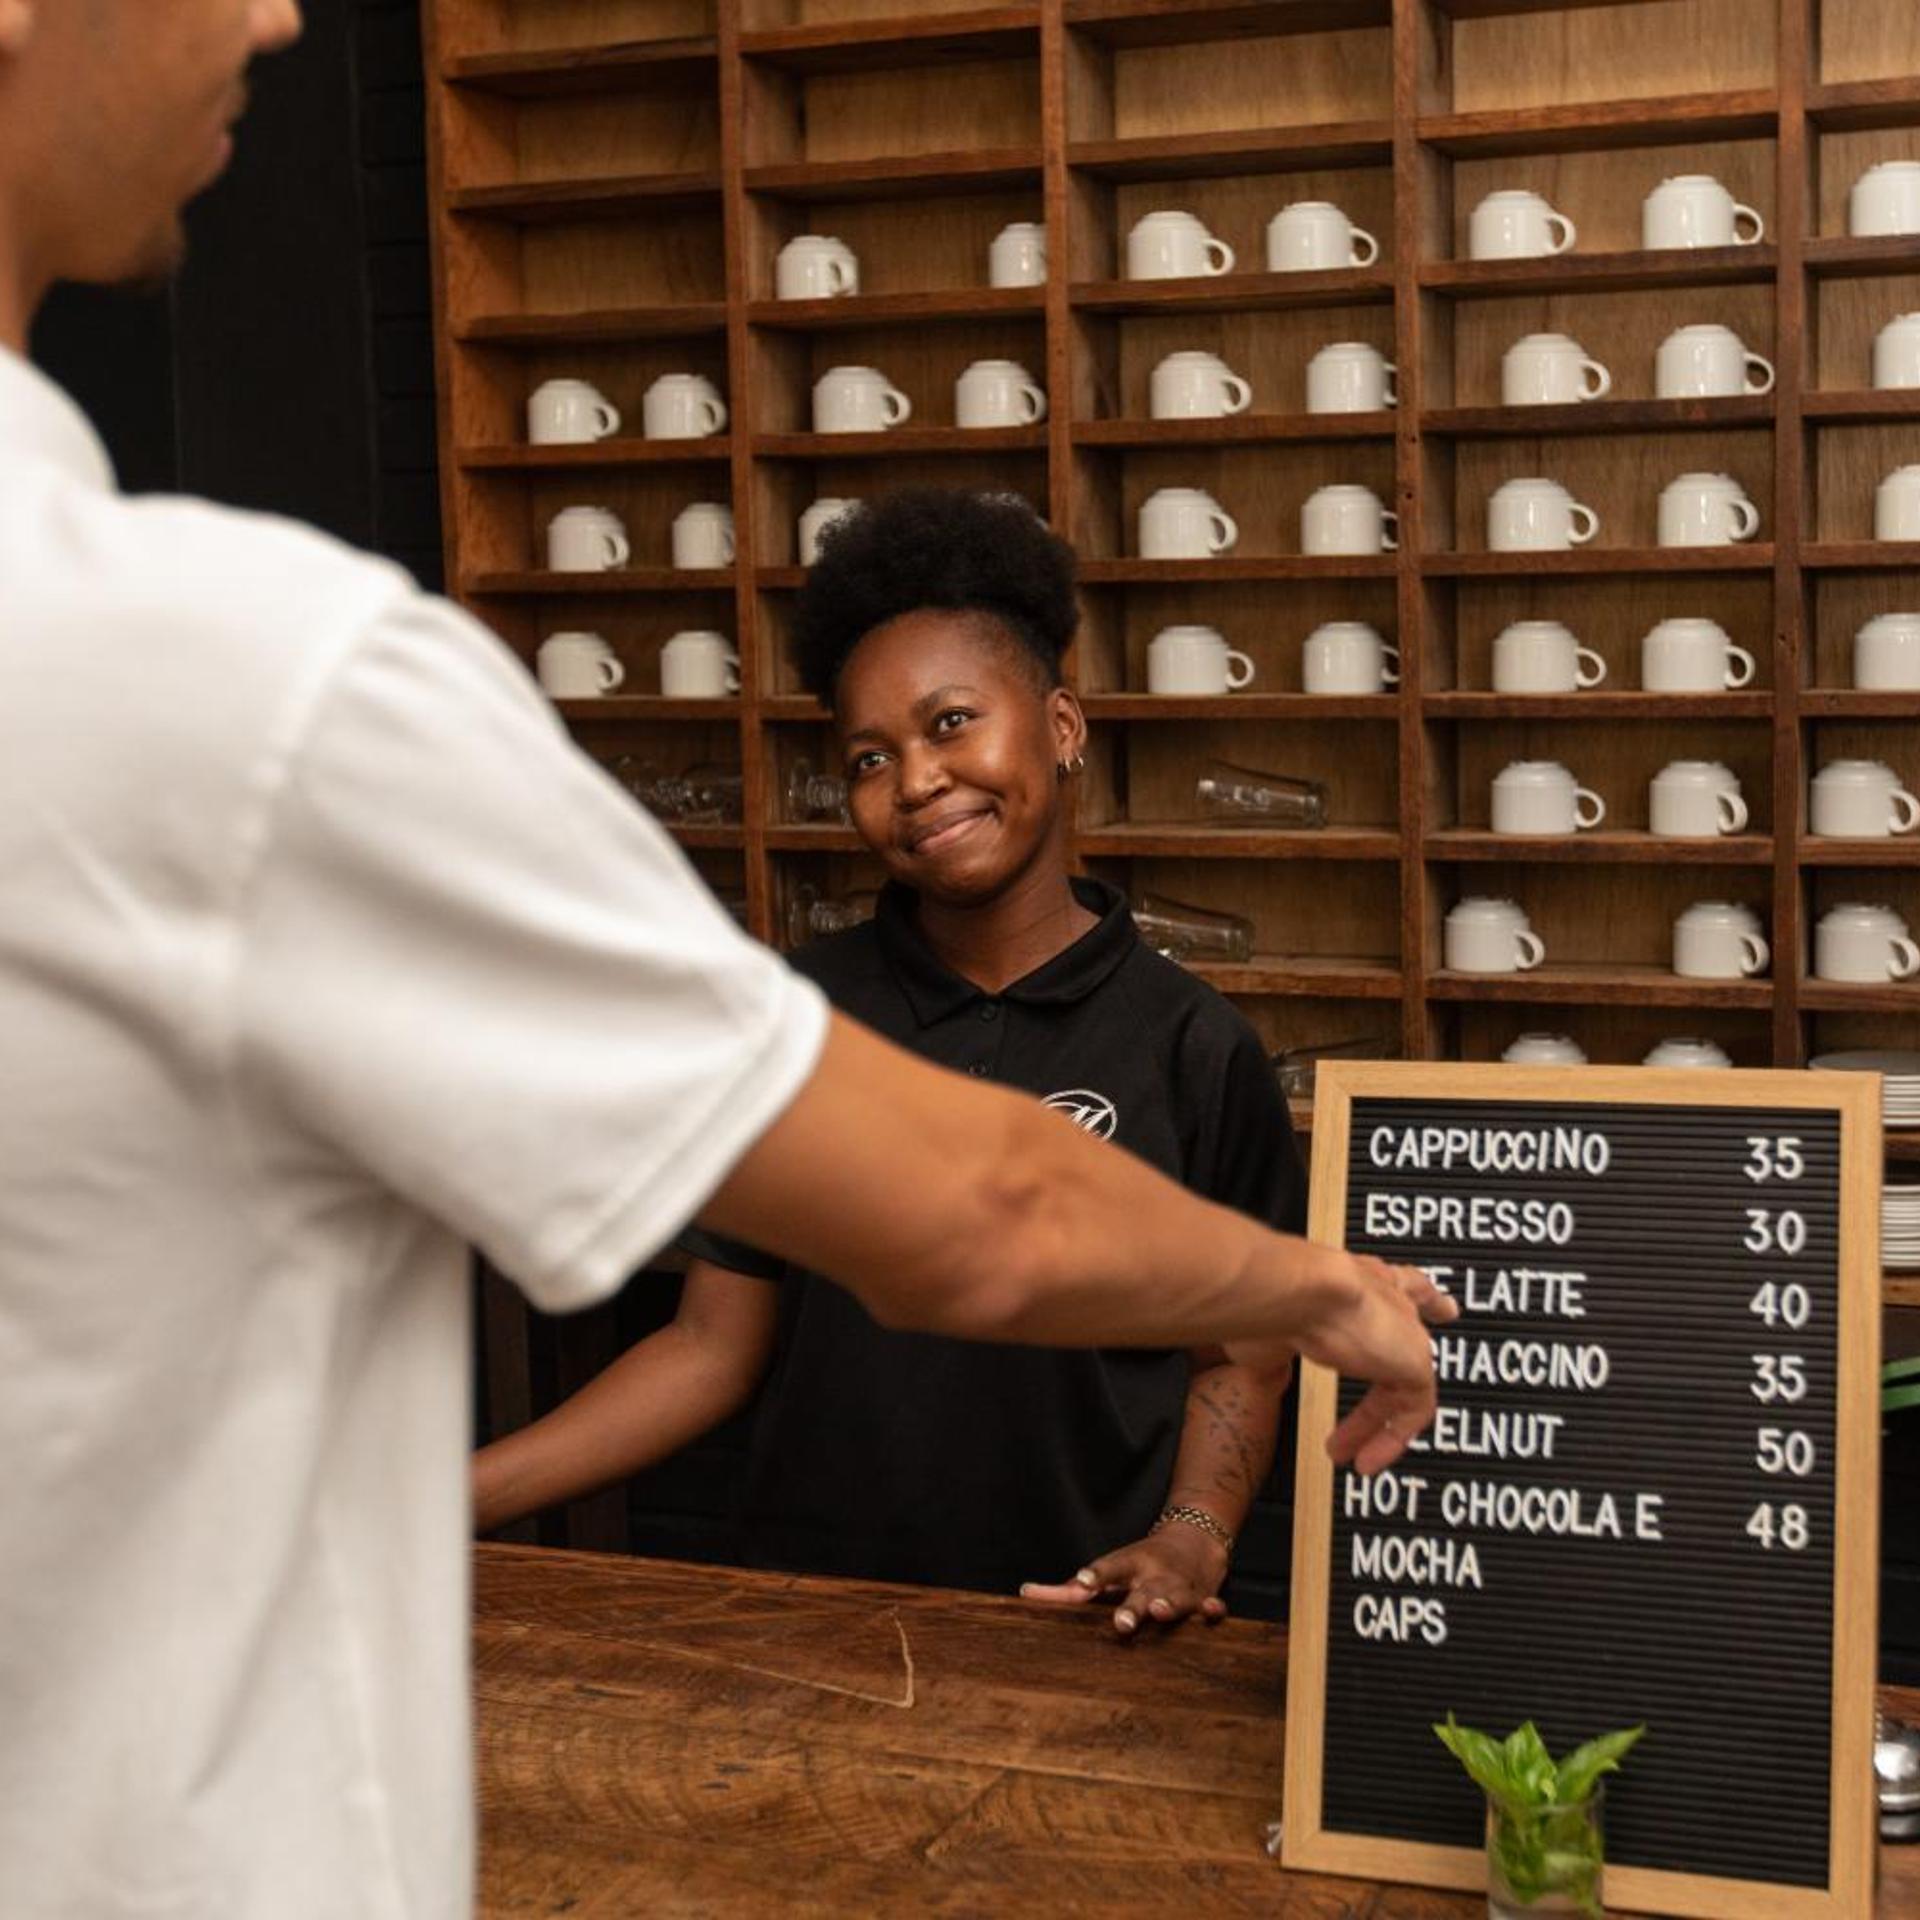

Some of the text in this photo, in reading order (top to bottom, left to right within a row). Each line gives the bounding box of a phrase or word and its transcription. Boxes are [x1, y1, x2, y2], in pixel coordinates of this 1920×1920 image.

[1369, 1125, 1805, 1184] CAPPUCCINO 35
[1364, 1192, 1807, 1256] ESPRESSO 30
[1464, 1267, 1588, 1318] LATTE
[1748, 1281, 1812, 1330] 40
[1749, 1354, 1807, 1403] 35
[1755, 1427, 1815, 1477] 50
[1344, 1470, 1429, 1521] HOT
[1745, 1502, 1809, 1551] 48
[1351, 1533, 1483, 1589] MOCHA
[1353, 1594, 1448, 1645] CAPS
